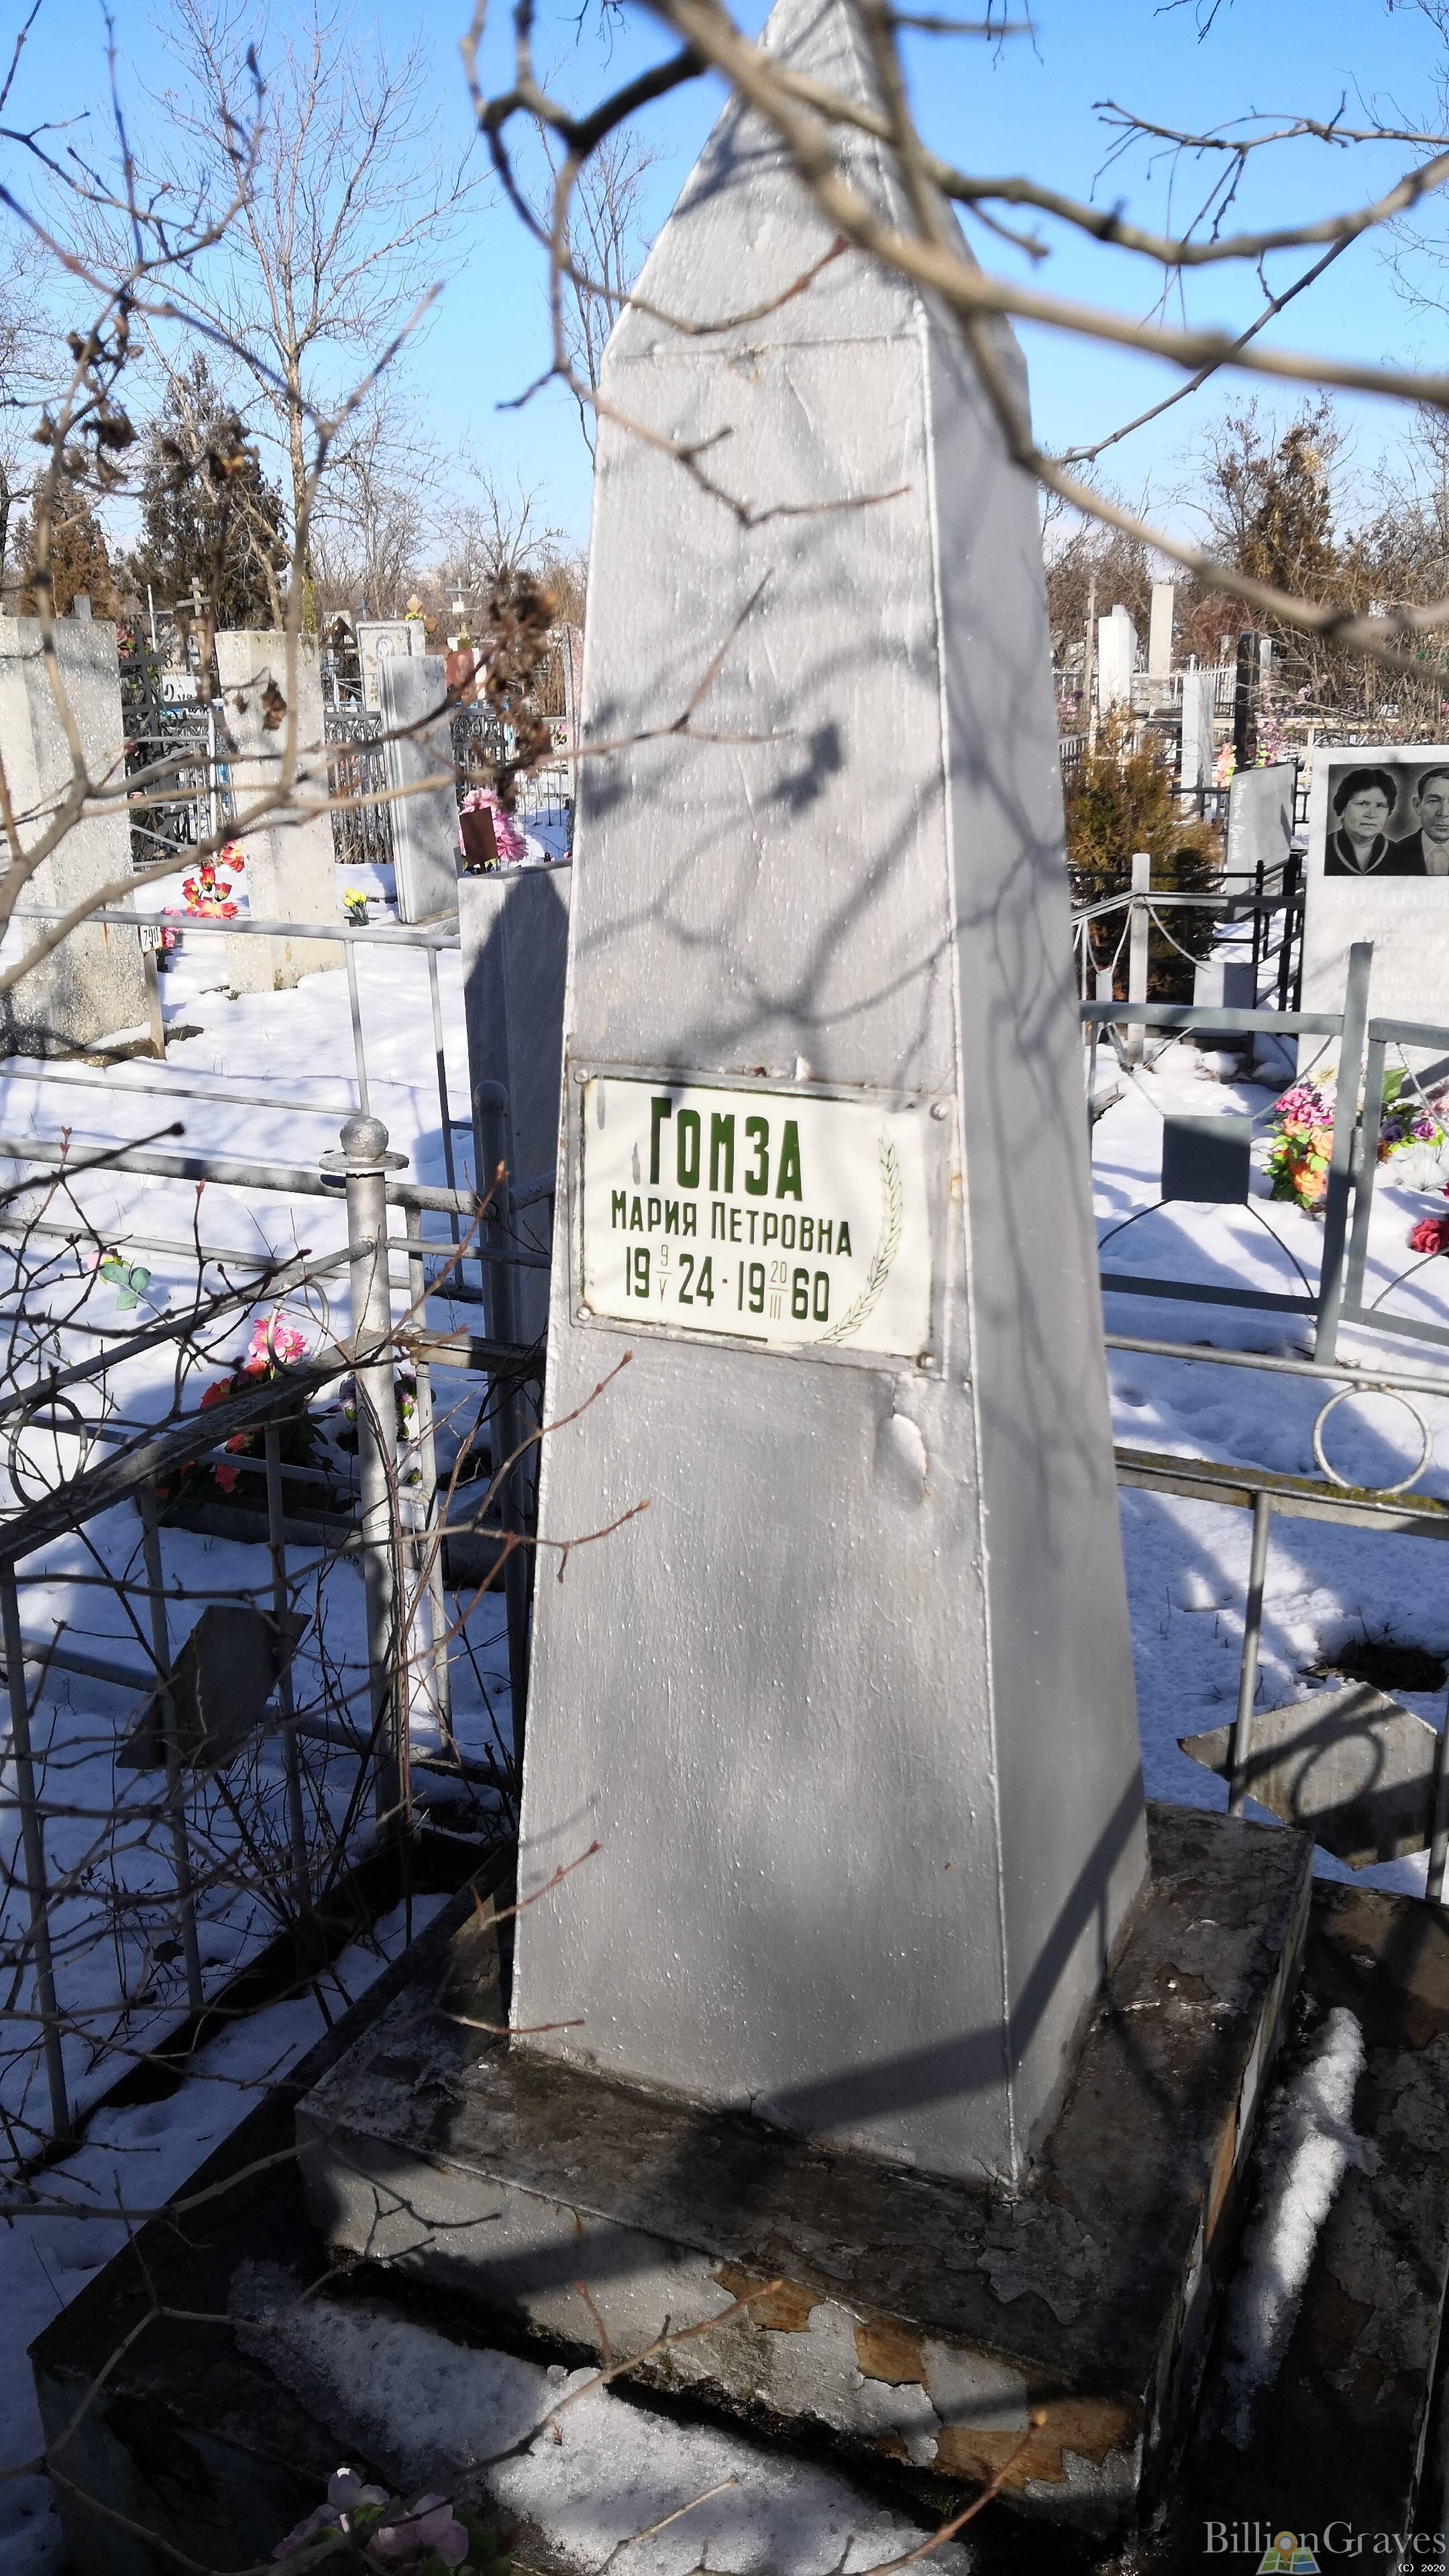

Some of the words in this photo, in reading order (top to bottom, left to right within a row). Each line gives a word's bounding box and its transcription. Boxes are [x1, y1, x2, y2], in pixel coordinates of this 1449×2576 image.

[649, 1096, 803, 1203] ГОМЗА
[611, 1189, 698, 1238] МАРИЯ
[711, 1201, 853, 1258] ПЕТРОВНА
[626, 1246, 651, 1299] 19
[791, 1267, 830, 1323] 60
[771, 1260, 788, 1284] 20
